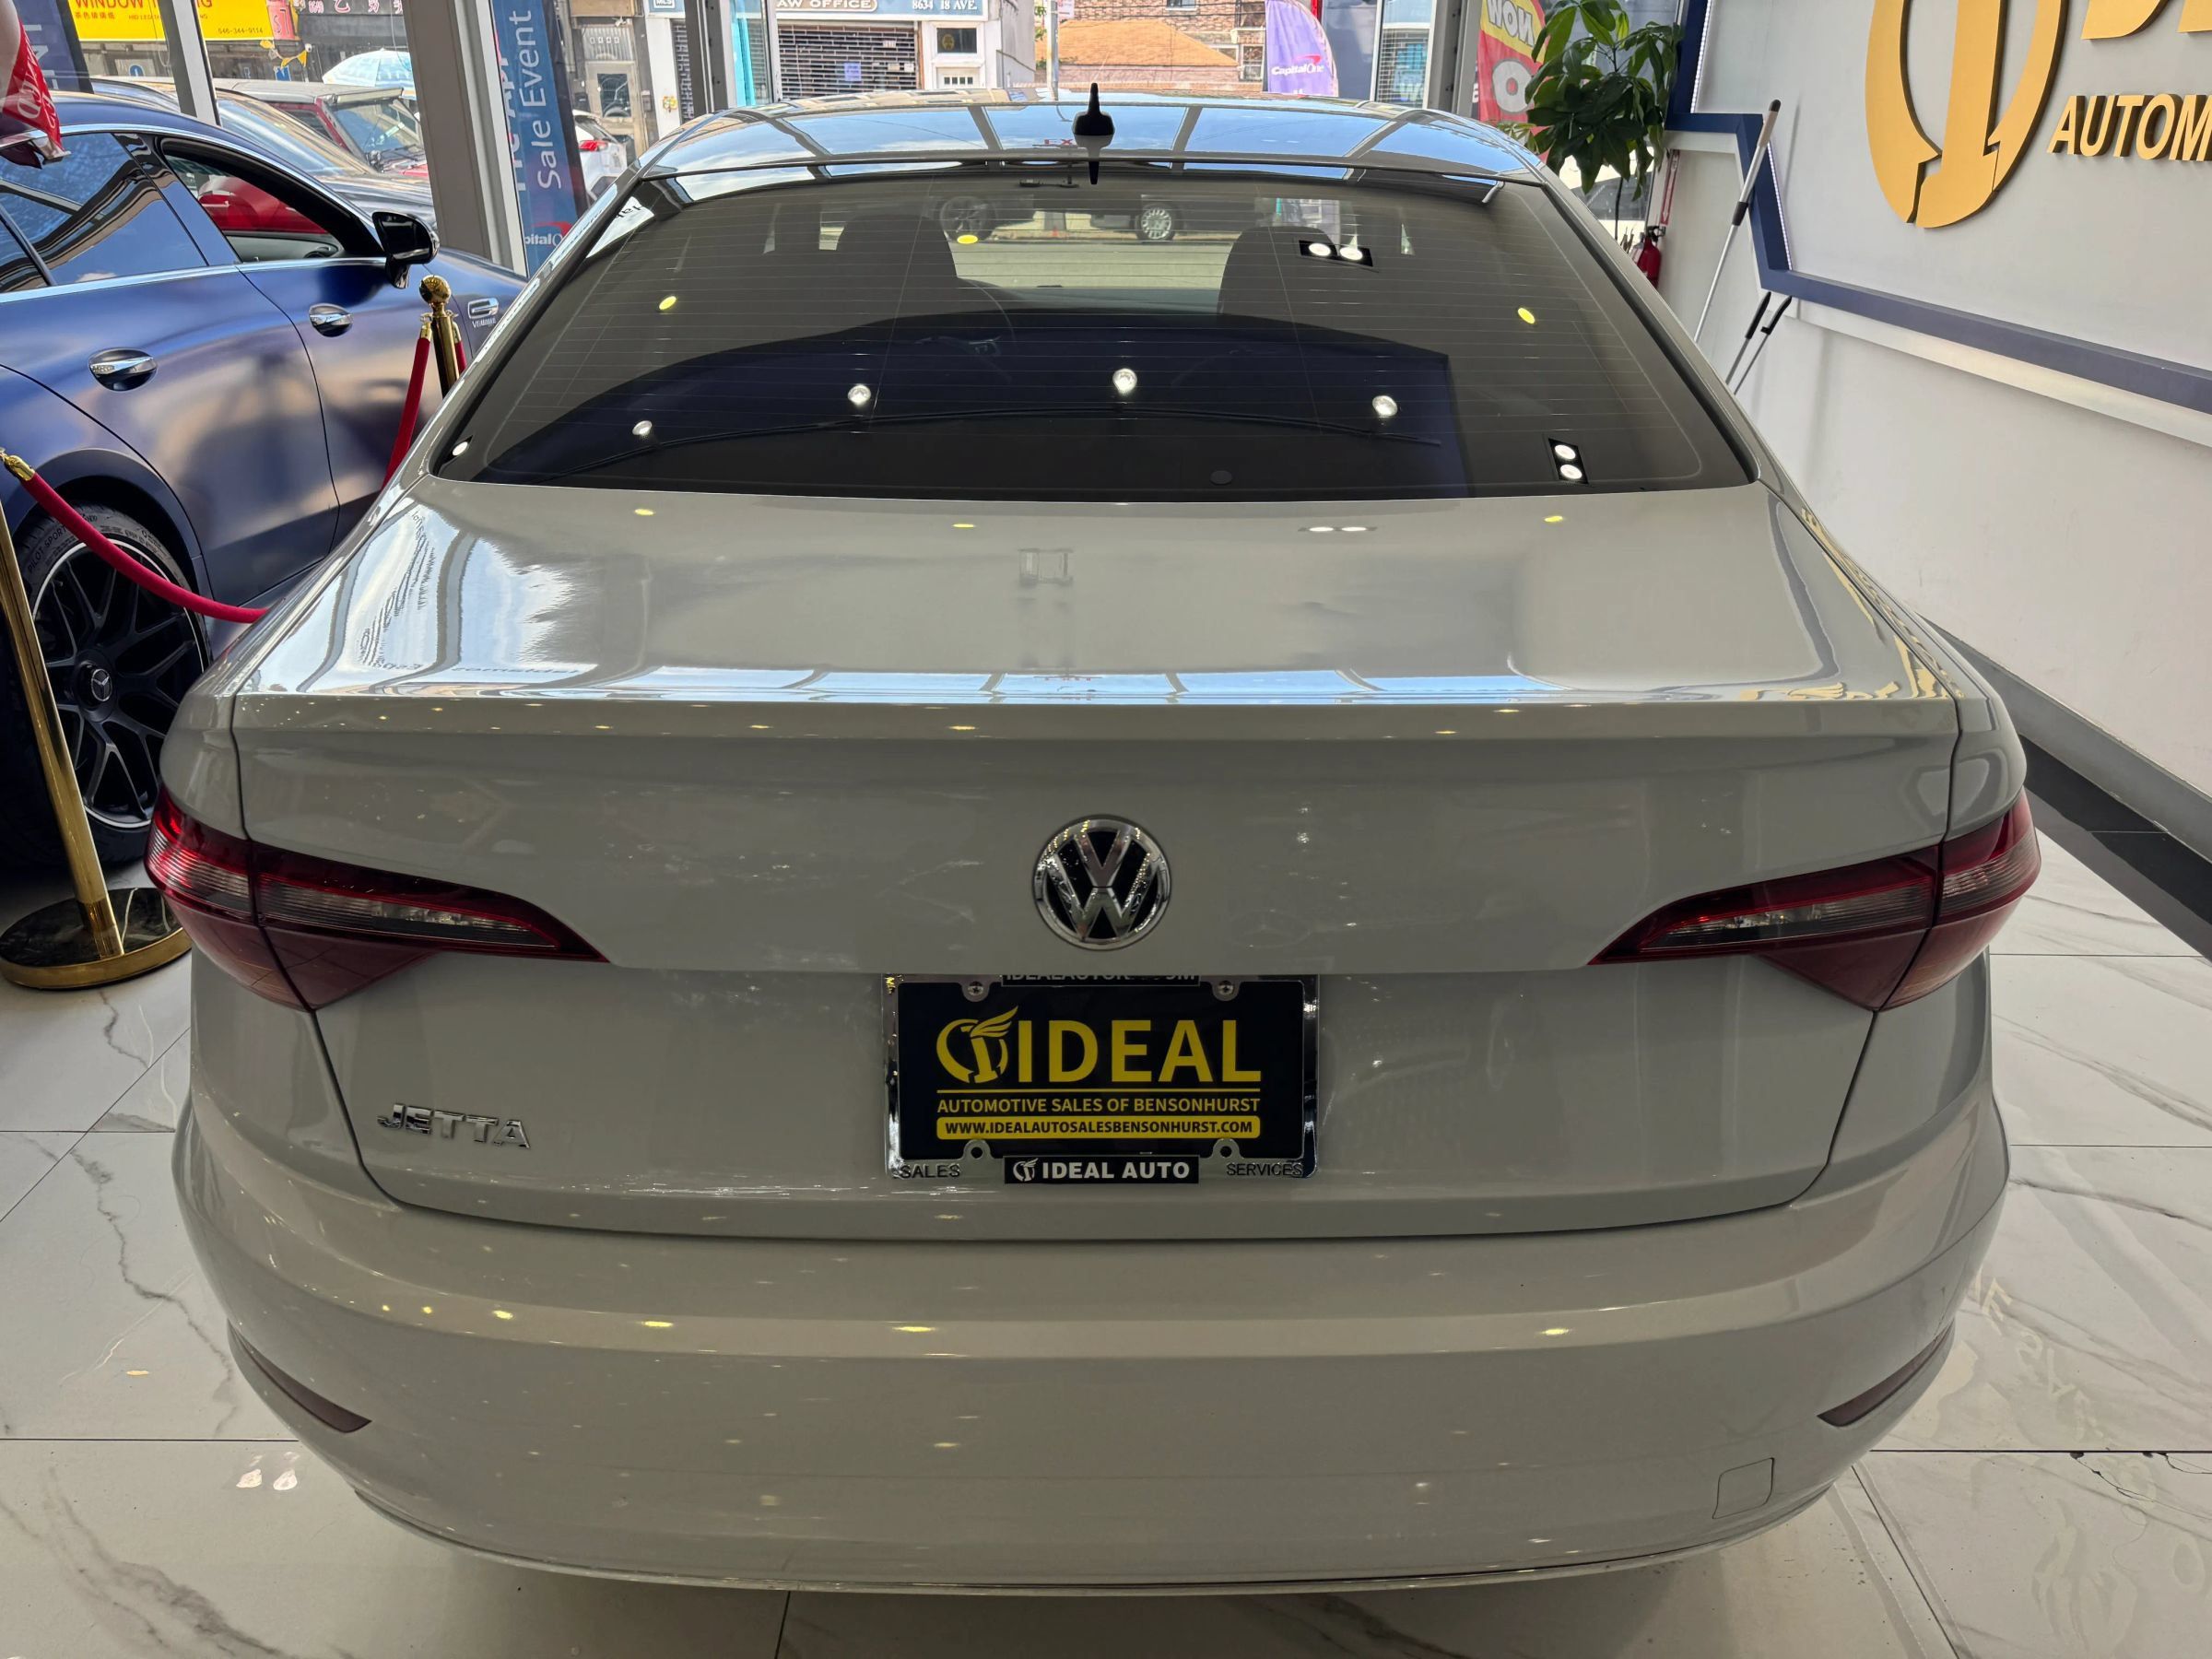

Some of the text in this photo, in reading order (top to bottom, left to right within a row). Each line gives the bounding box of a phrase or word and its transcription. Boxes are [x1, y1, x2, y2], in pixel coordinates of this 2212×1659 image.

[809, 0, 872, 8] OFFICE
[953, 0, 978, 9] AVE.
[509, 10, 561, 190] Sale Event
[1018, 1019, 1262, 1083] IDEAL
[937, 1097, 1260, 1113] AUTOMOTIVE SALES OF BENSONHURST
[376, 1102, 531, 1149] JETTA
[945, 1120, 1253, 1135] WWW.IDEALAUTOSALESBENSONHURST.COM
[900, 1163, 960, 1179] SALES
[1042, 1161, 1191, 1179] IDEAL AUTO
[1226, 1161, 1303, 1178] SERVICES
